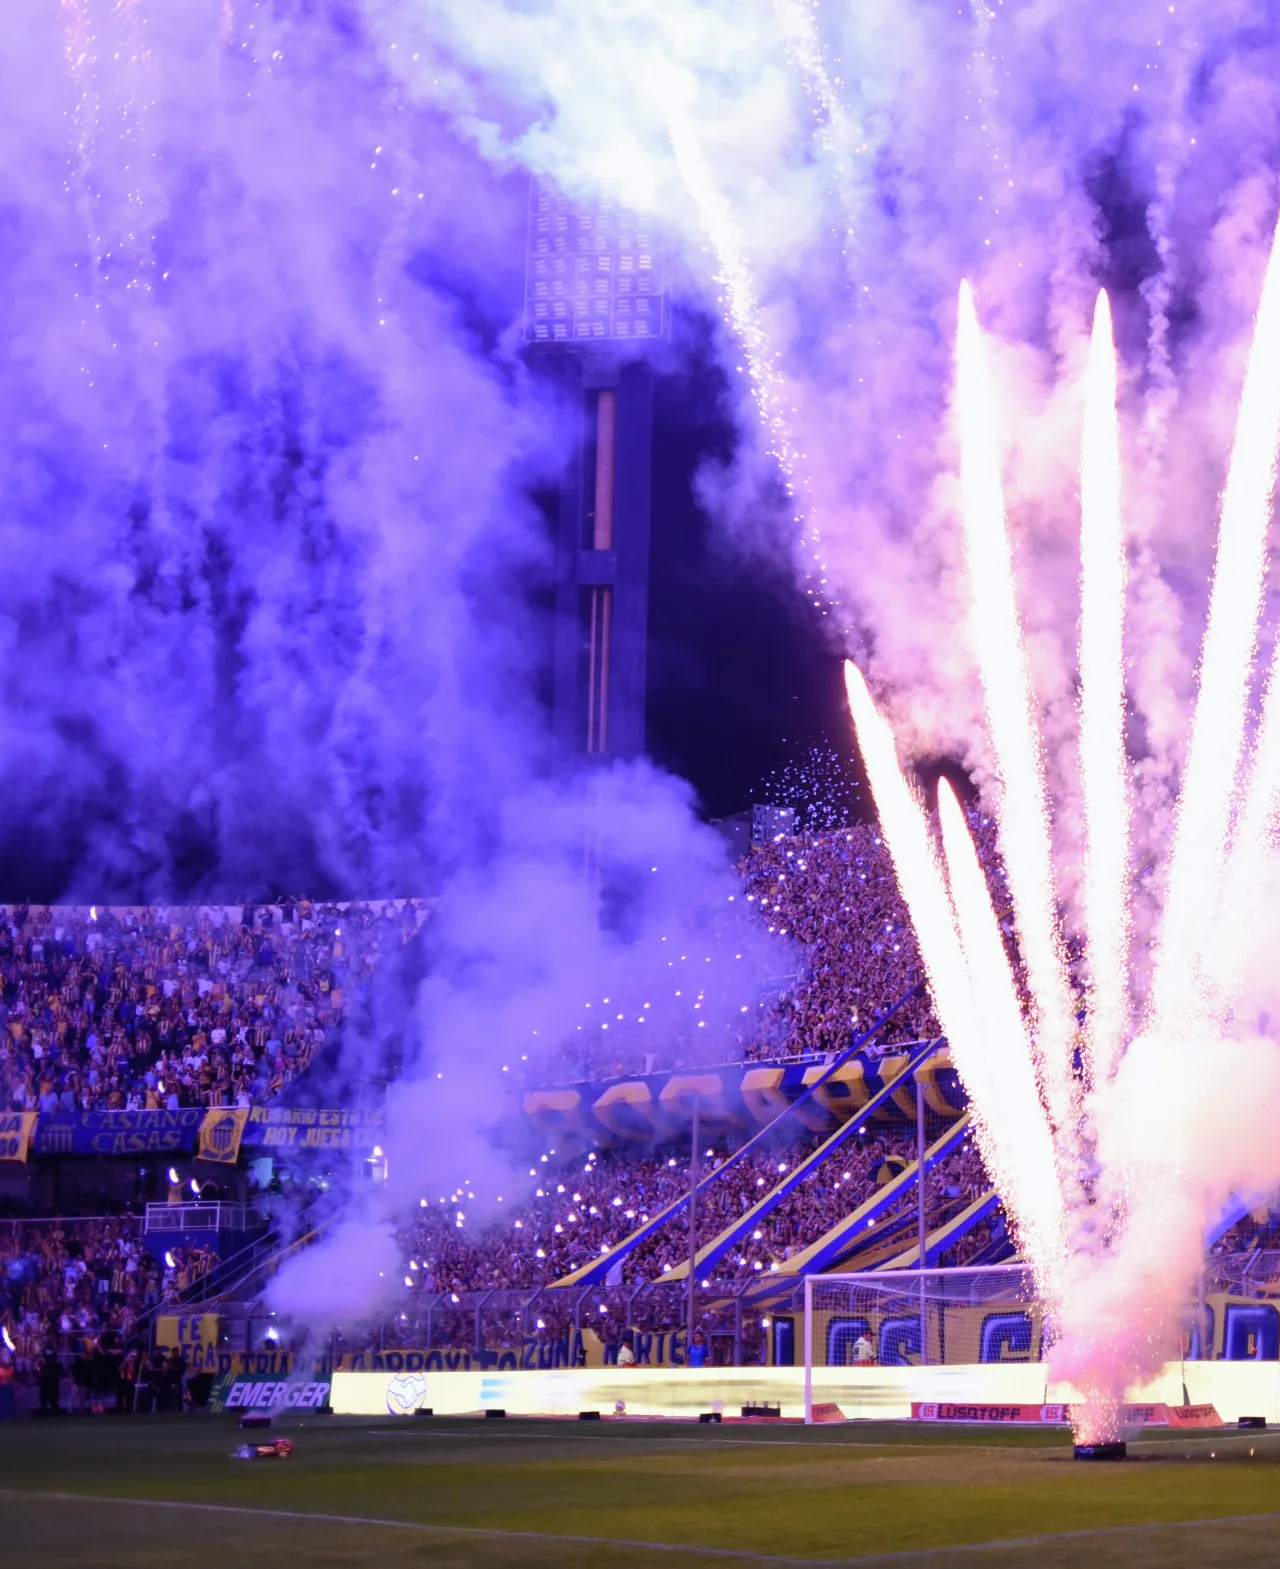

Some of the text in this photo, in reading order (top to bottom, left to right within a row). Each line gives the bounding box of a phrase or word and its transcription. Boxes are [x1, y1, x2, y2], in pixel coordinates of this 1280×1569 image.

[82, 1110, 198, 1129] CASIANO
[92, 1130, 181, 1152] CASAS
[263, 1126, 298, 1145] HOY
[300, 1128, 350, 1148] JUEGA
[178, 1315, 202, 1342] FE
[224, 1382, 330, 1407] EMERGER
